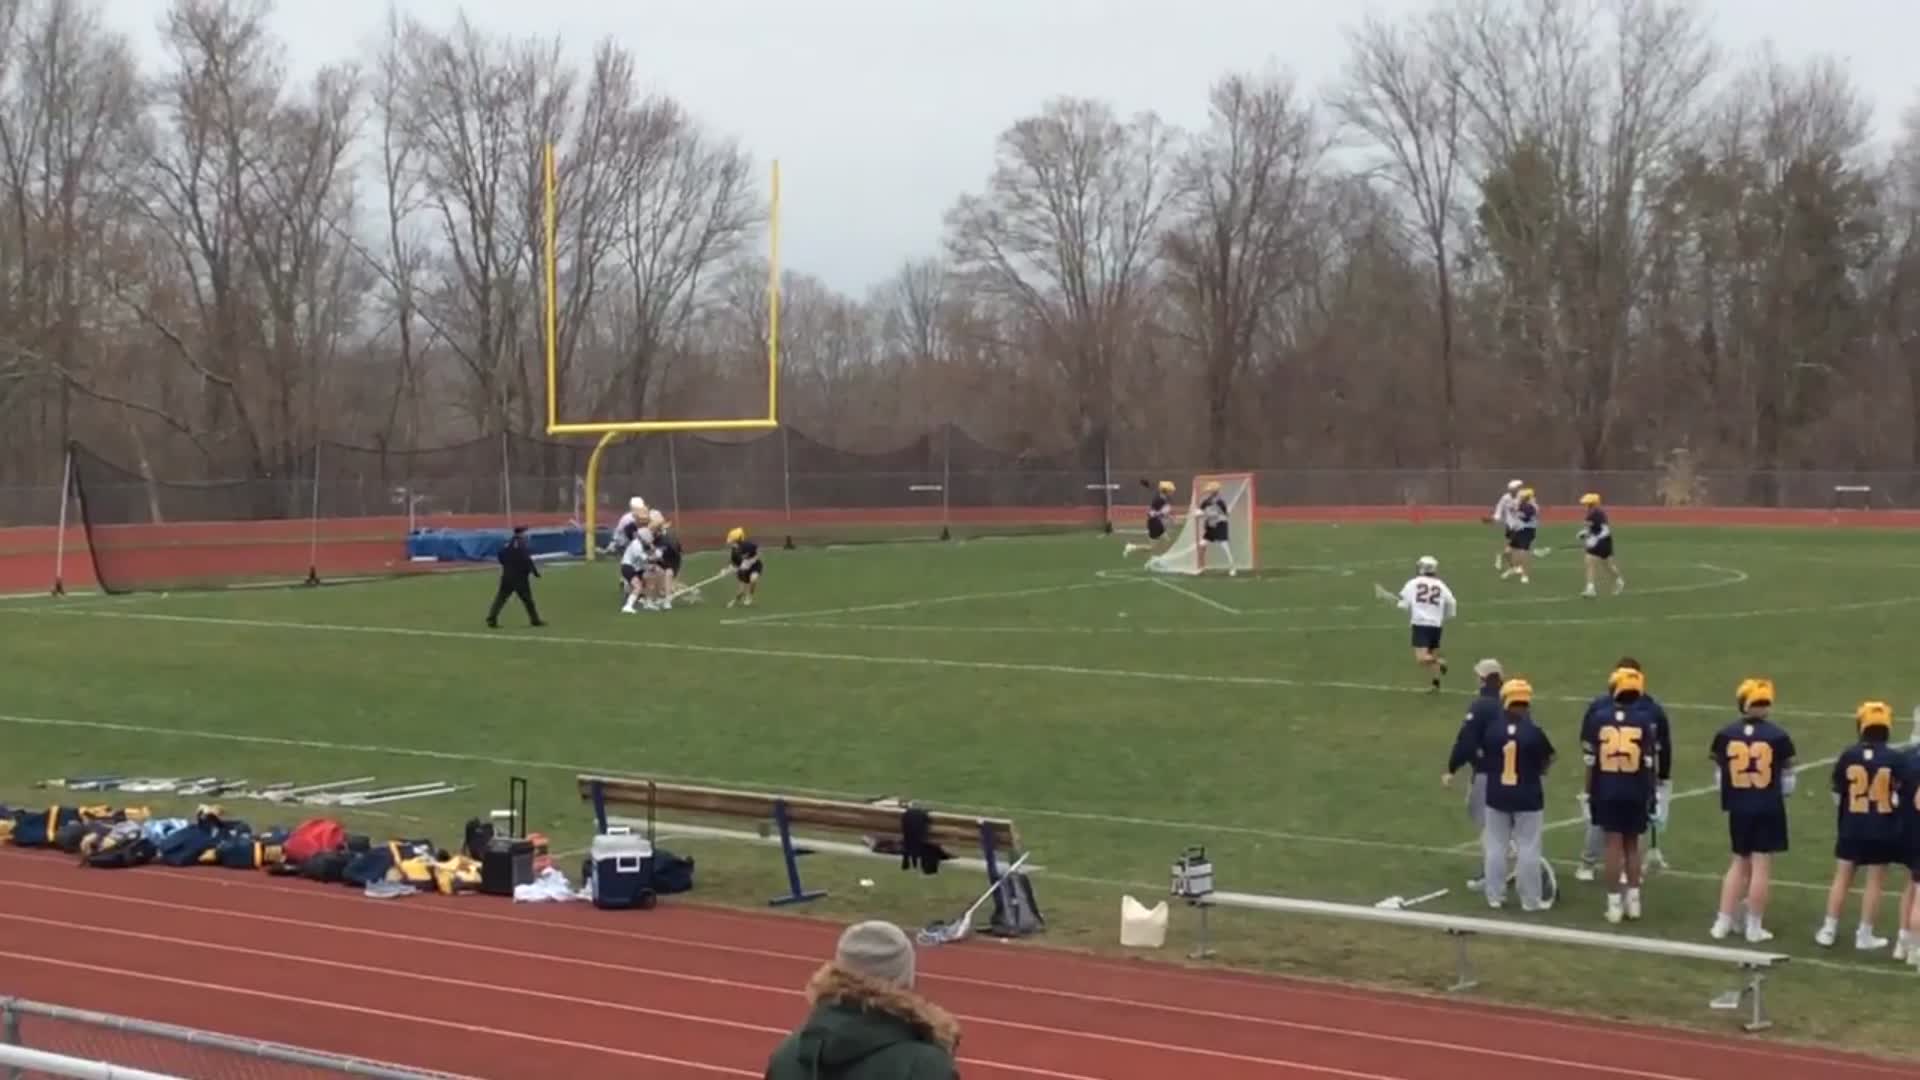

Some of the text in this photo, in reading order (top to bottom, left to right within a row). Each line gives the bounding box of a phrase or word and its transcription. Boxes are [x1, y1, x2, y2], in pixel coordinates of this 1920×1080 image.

[1416, 583, 1440, 606] 22
[1502, 741, 1518, 786] 1
[1599, 726, 1643, 773] 25
[1727, 741, 1774, 788] 23
[1846, 765, 1893, 813] 24
